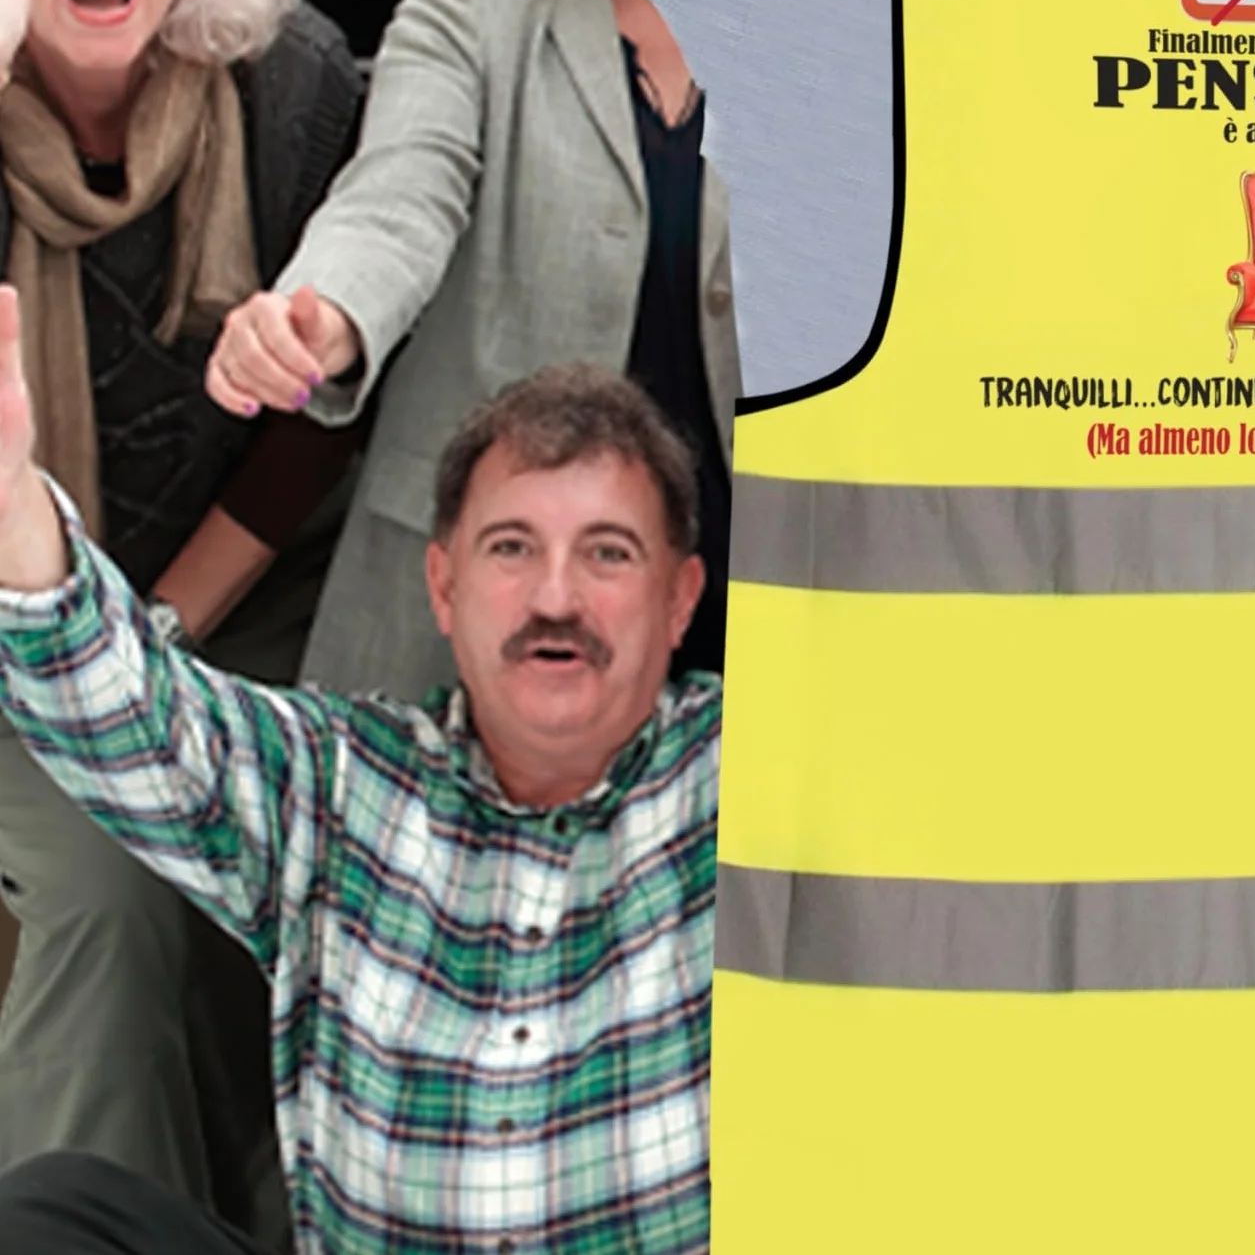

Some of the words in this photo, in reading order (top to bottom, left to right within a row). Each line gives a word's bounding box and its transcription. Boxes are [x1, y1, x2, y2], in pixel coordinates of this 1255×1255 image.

[1223, 117, 1238, 143] è
[1087, 423, 1130, 458] (Ma
[1138, 423, 1231, 456] almeno
